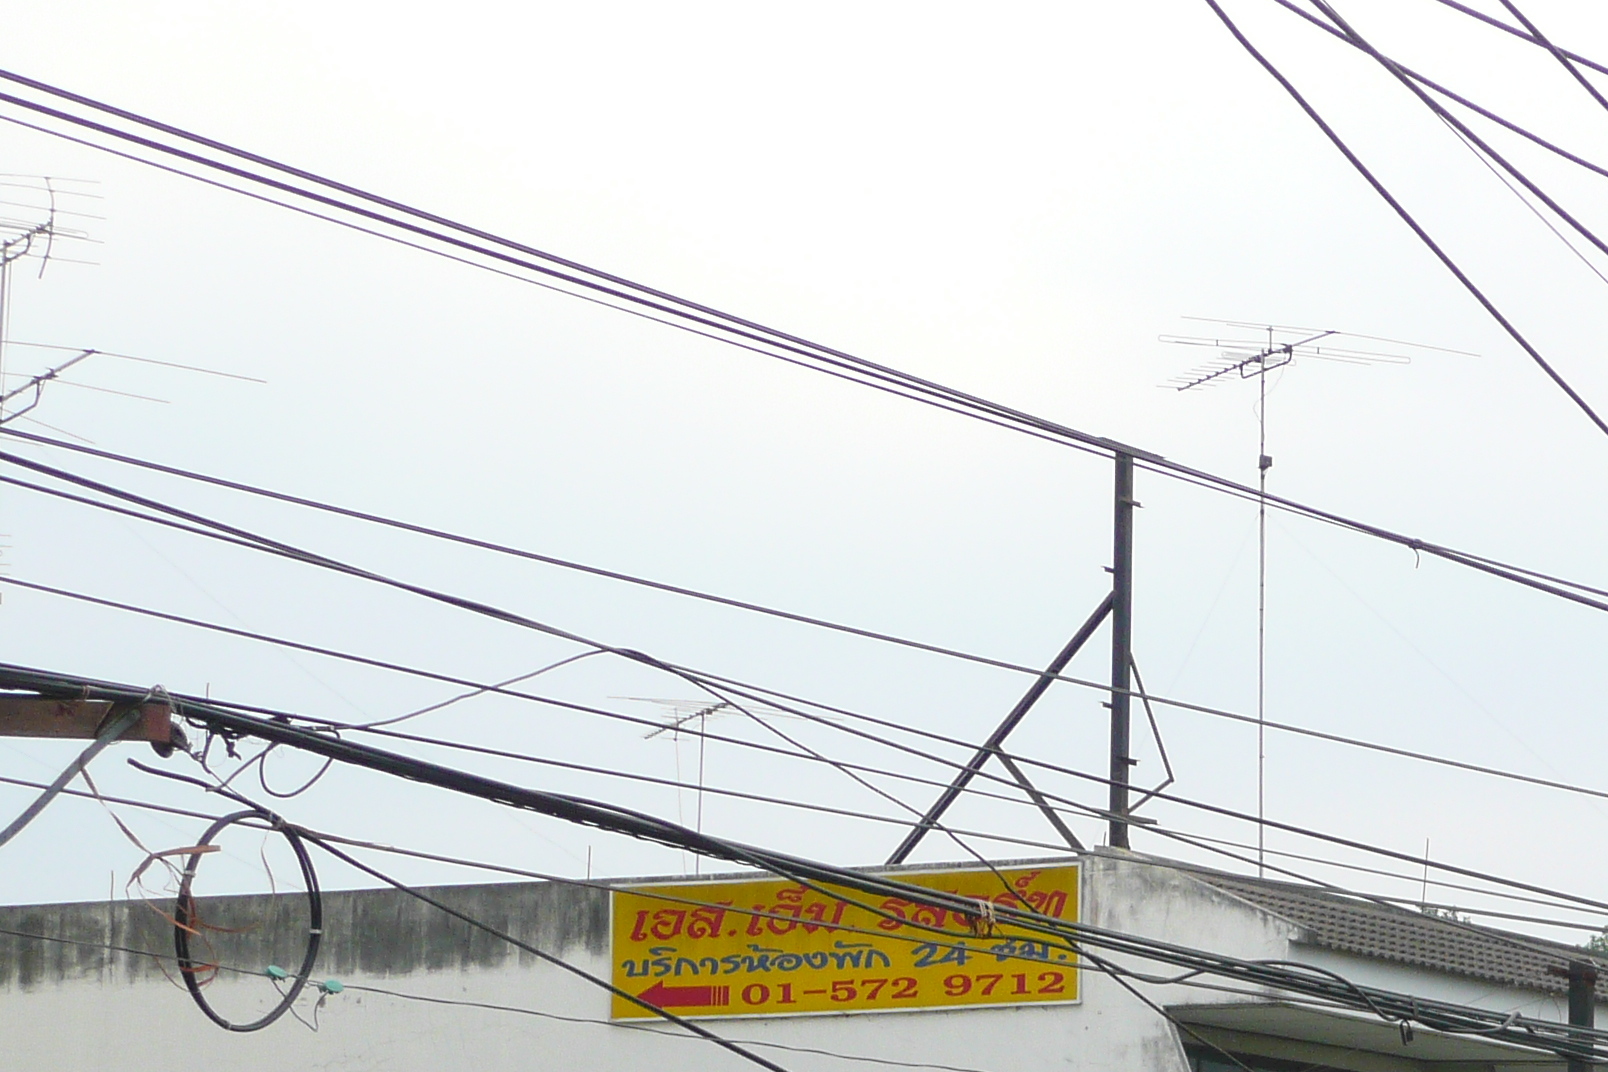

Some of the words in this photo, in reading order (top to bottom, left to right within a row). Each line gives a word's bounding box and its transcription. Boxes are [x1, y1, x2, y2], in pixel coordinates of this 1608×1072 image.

[877, 871, 1069, 931] รสร์ท
[621, 940, 891, 978] บริการห้องพัก
[911, 940, 973, 969] 24
[741, 976, 919, 1006] 01-572
[943, 971, 1066, 997] 9712
